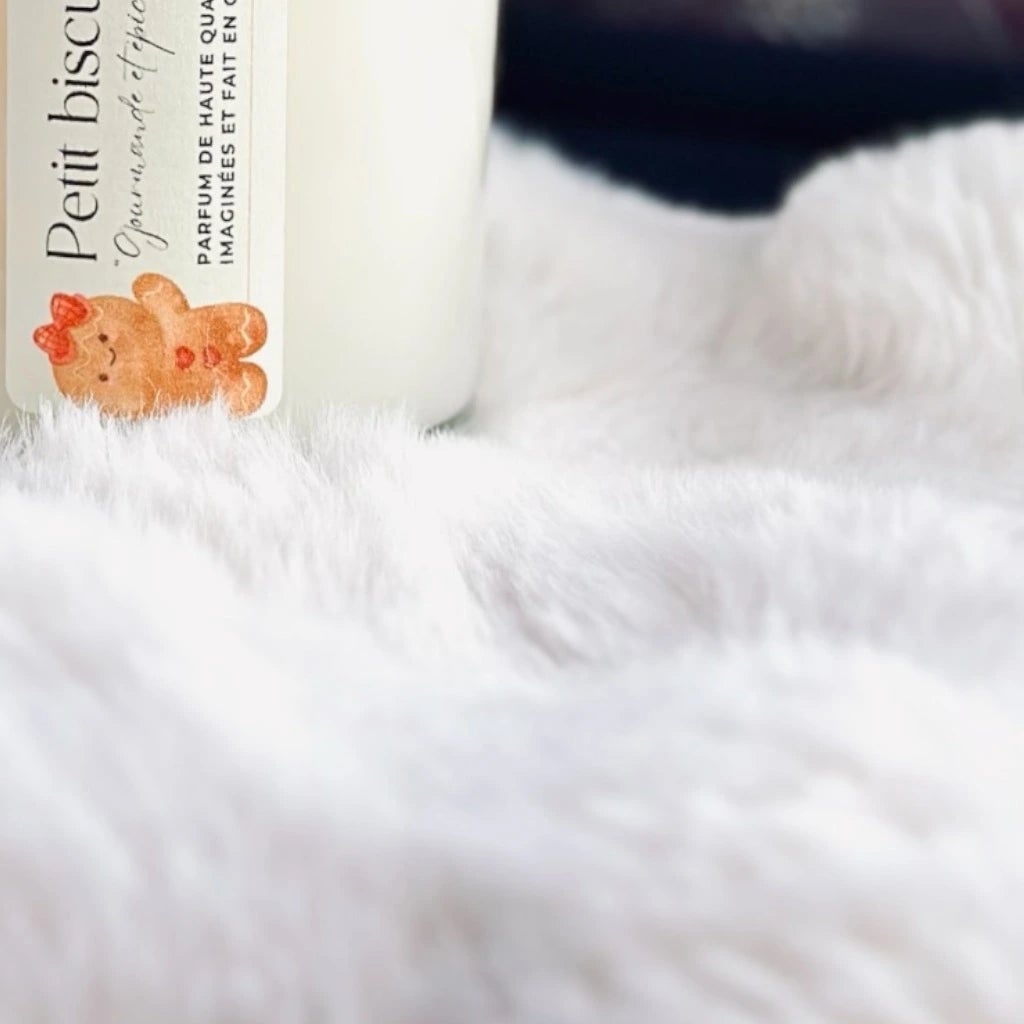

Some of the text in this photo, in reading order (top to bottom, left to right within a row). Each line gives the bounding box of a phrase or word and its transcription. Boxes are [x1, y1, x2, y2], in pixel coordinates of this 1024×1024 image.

[222, 15, 238, 44] EN
[116, 44, 159, 81] et
[221, 52, 238, 101] FAIT
[199, 53, 215, 127] HAUTE
[221, 109, 237, 135] ET
[198, 136, 214, 164] DE
[46, 143, 100, 261] Petit
[197, 175, 213, 265] PARFUM
[217, 143, 236, 265] IMAGINÉES
